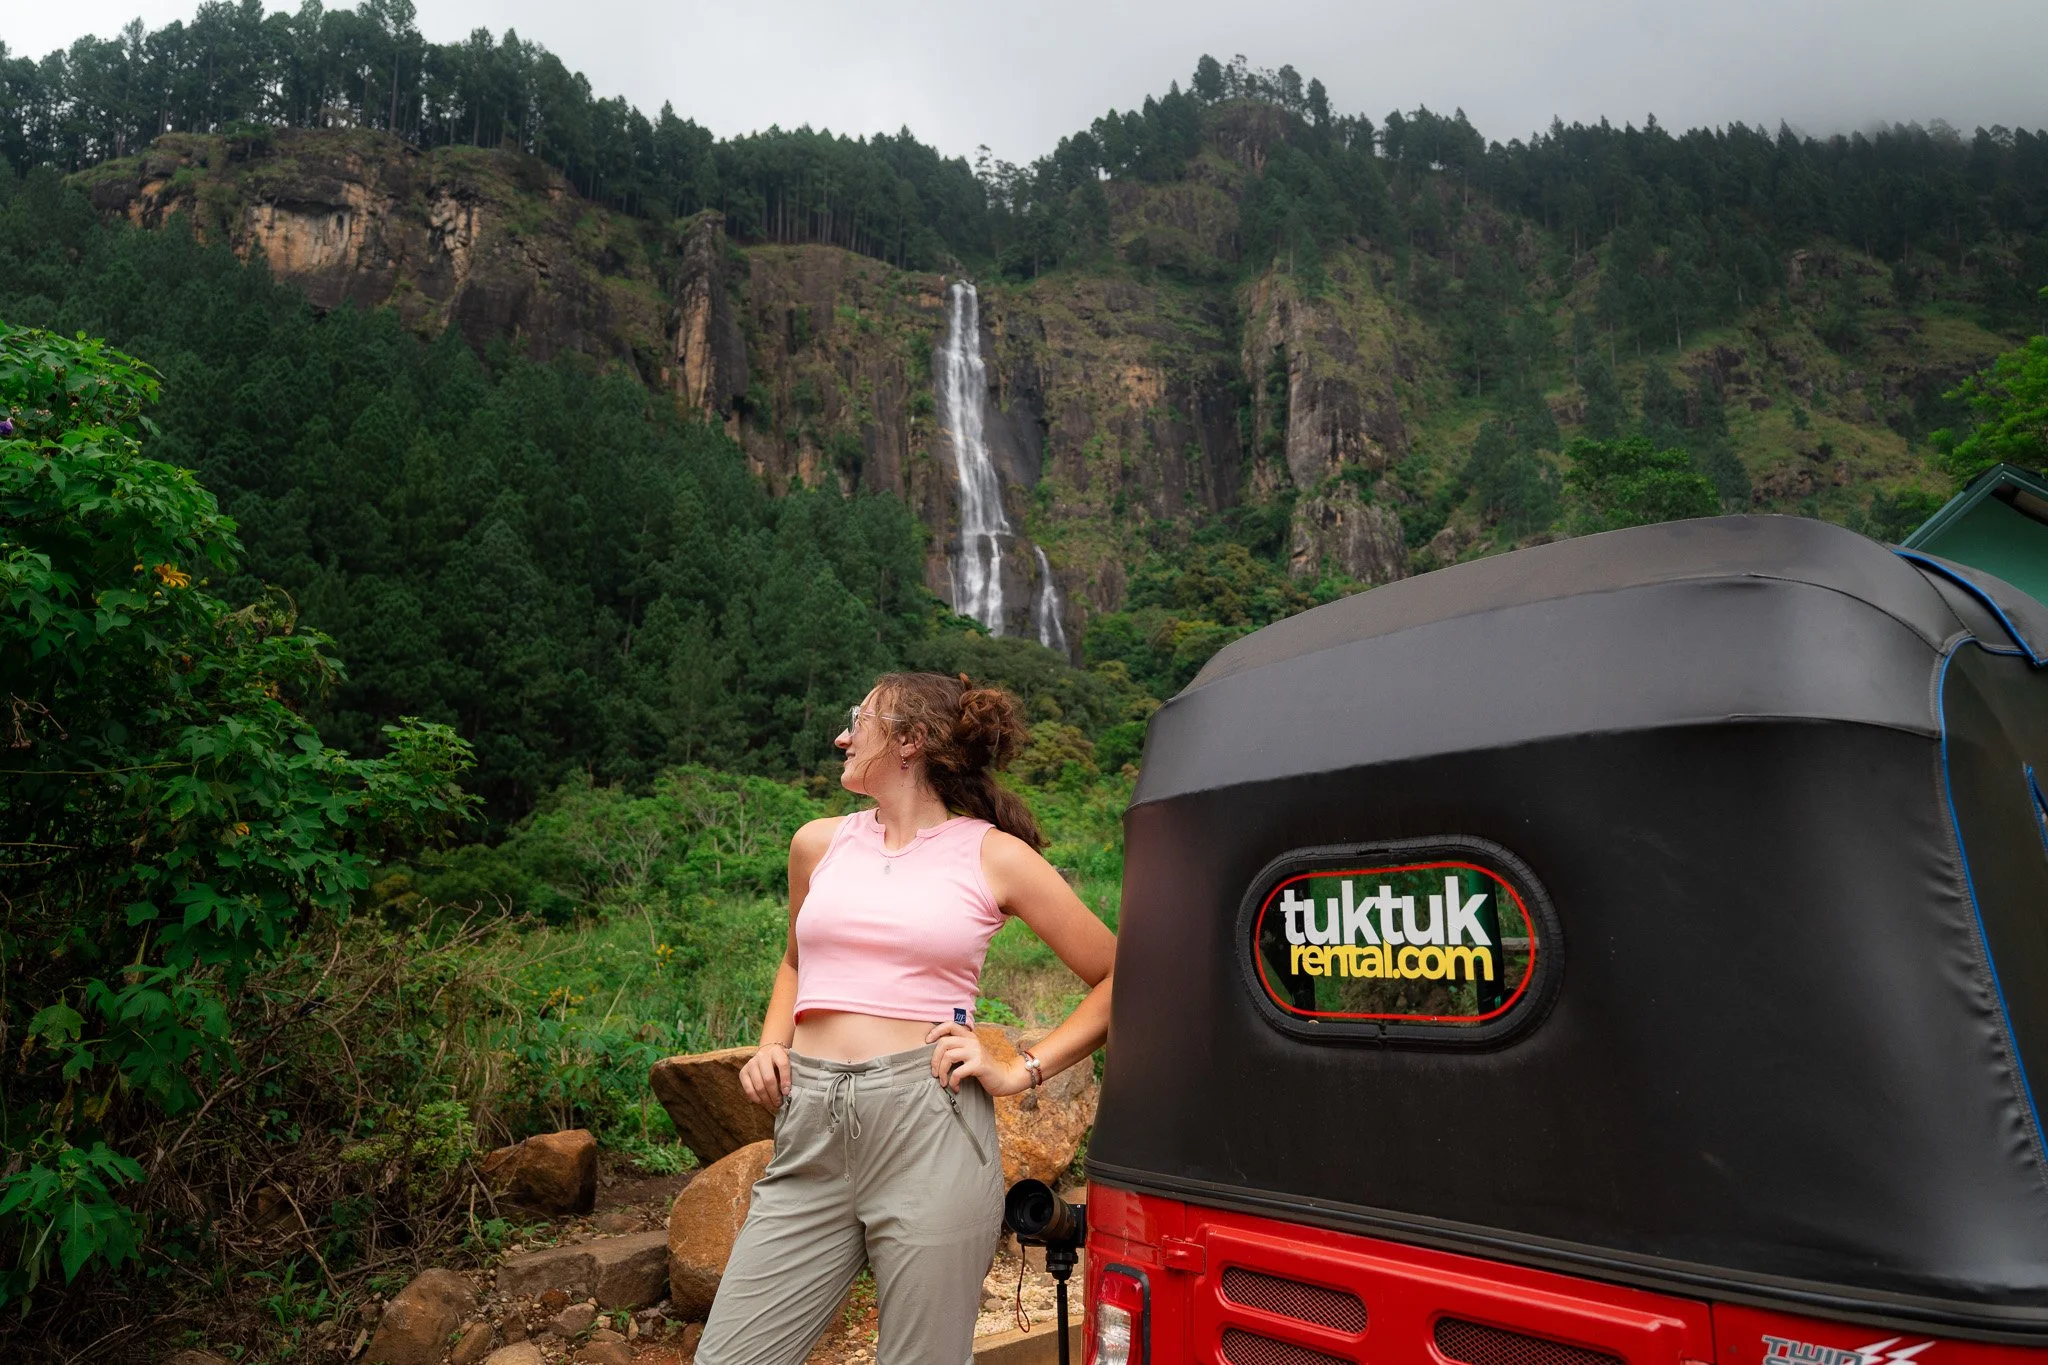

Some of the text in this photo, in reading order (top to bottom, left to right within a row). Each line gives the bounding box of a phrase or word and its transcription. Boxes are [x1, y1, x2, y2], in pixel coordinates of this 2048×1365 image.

[1280, 876, 1492, 946] tuktuk
[1290, 938, 1494, 981] rental.com
[1761, 1334, 1865, 1365] TWIN
